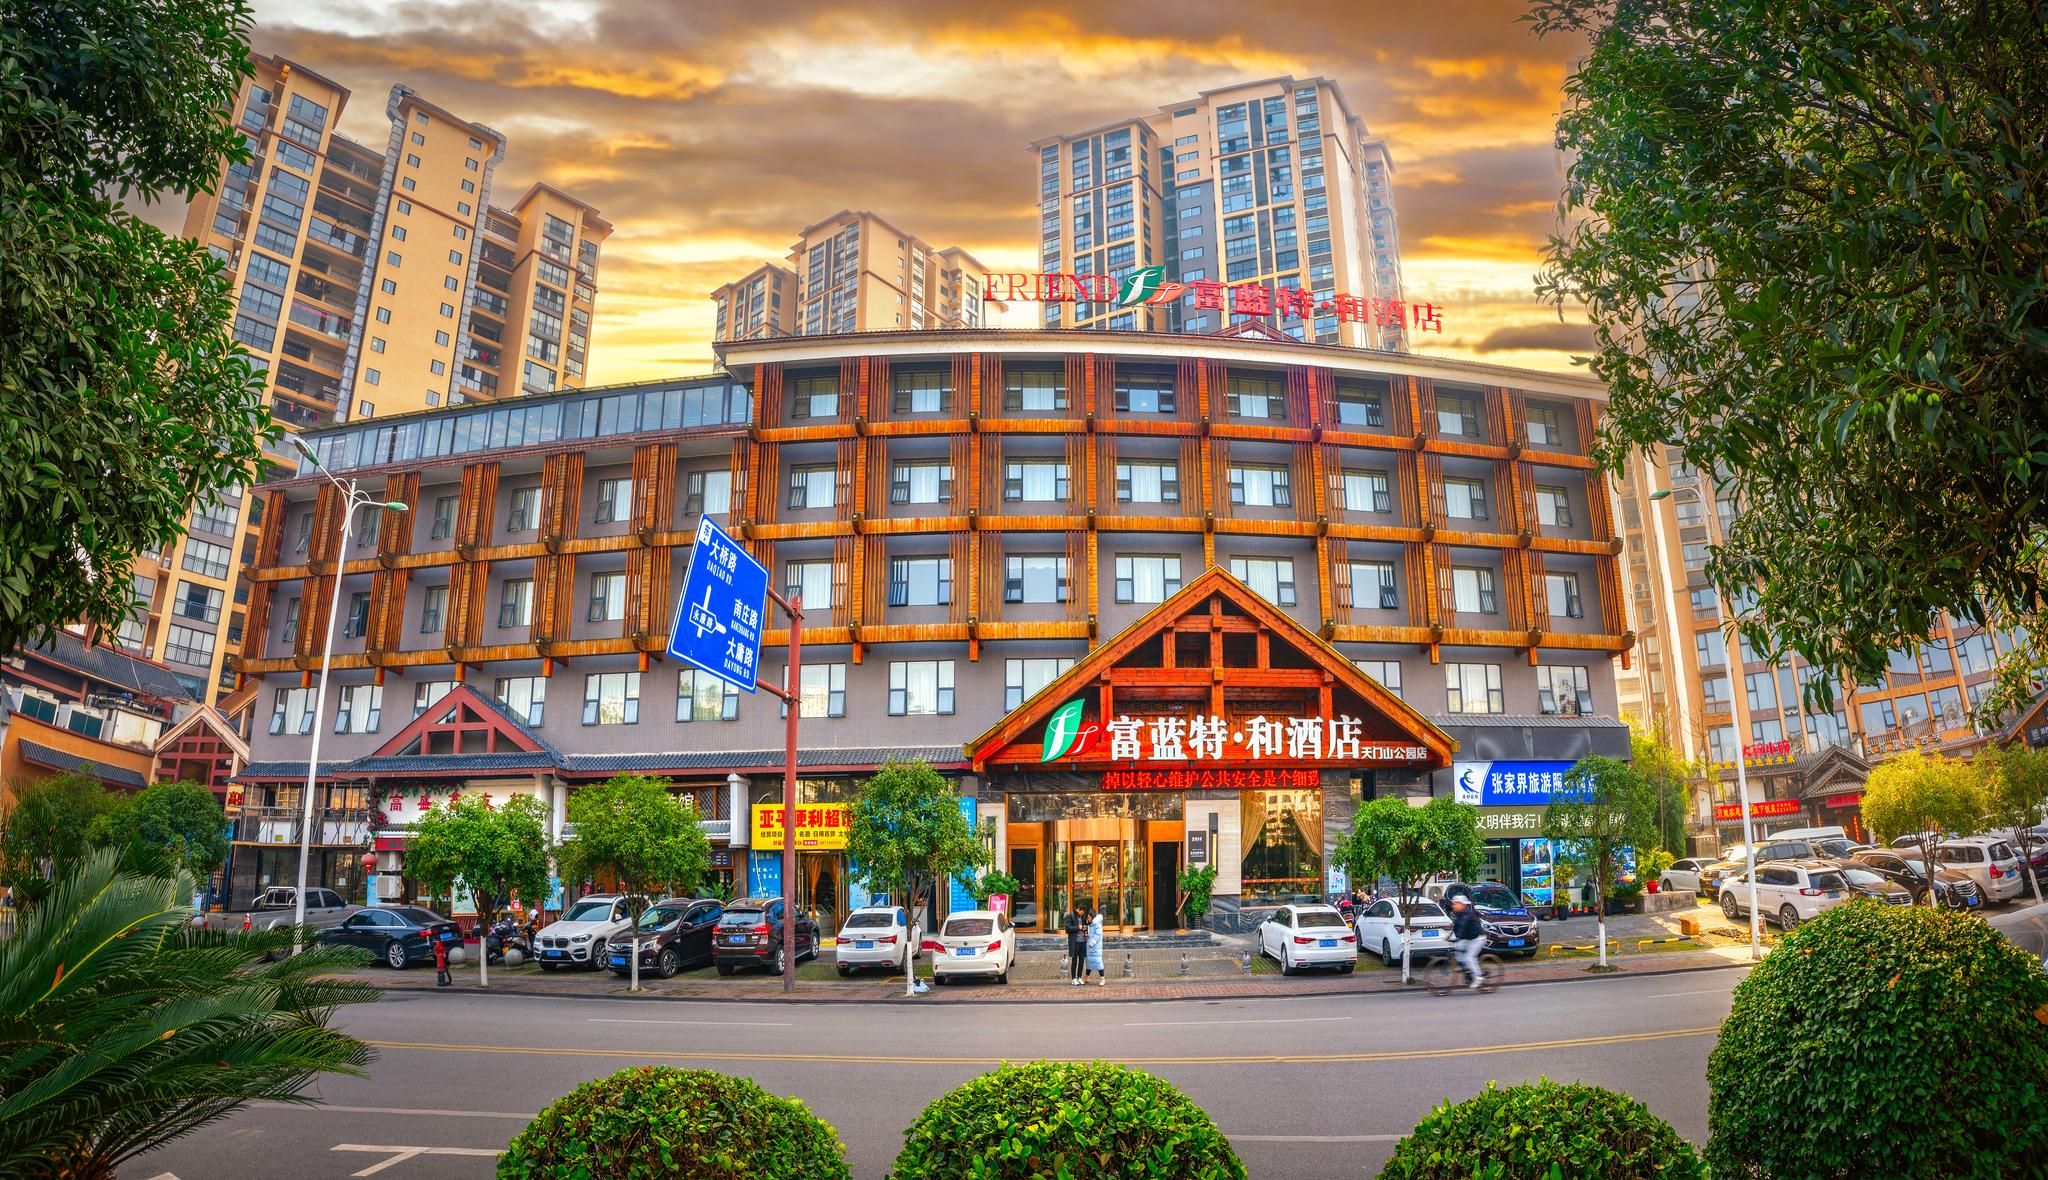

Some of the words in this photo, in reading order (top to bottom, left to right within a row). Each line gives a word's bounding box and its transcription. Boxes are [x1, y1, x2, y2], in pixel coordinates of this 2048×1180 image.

[982, 273, 1119, 302] FRIEND
[1189, 277, 1443, 334] 富蓝特·和酒店
[706, 559, 726, 581] DAQIAO
[709, 539, 737, 574] 大桥路
[733, 598, 759, 630] 南庄路
[723, 659, 743, 676] DAYONG
[725, 637, 754, 667] 大庸路
[1106, 714, 1362, 761] 富蓝特·和酒店
[1361, 746, 1428, 760] 天门山公园店
